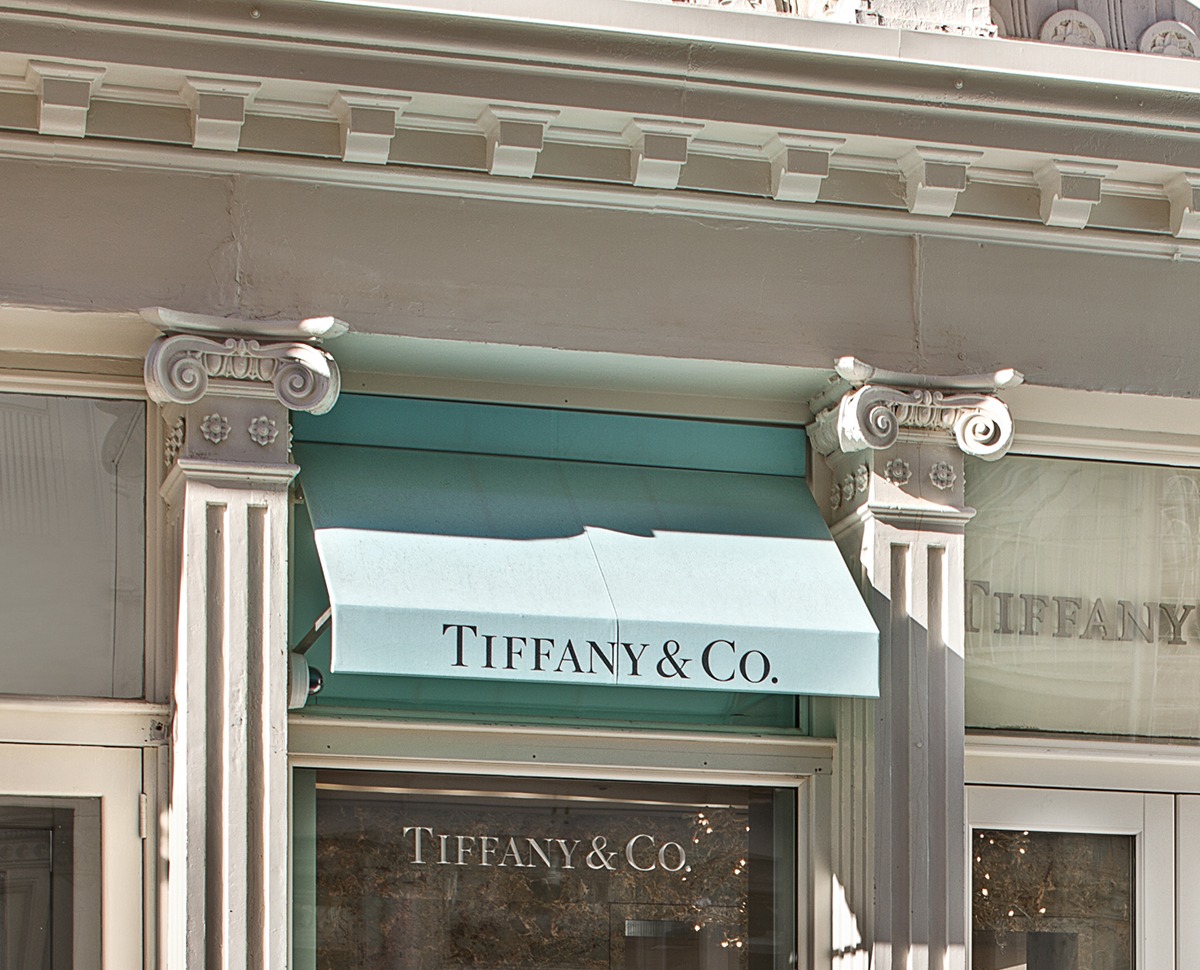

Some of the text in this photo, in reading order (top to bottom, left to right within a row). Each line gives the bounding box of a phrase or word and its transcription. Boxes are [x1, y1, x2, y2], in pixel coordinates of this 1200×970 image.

[442, 623, 650, 677] TIFFANY
[656, 639, 693, 680] &
[403, 826, 581, 869] TIFFANY
[585, 835, 618, 871] &
